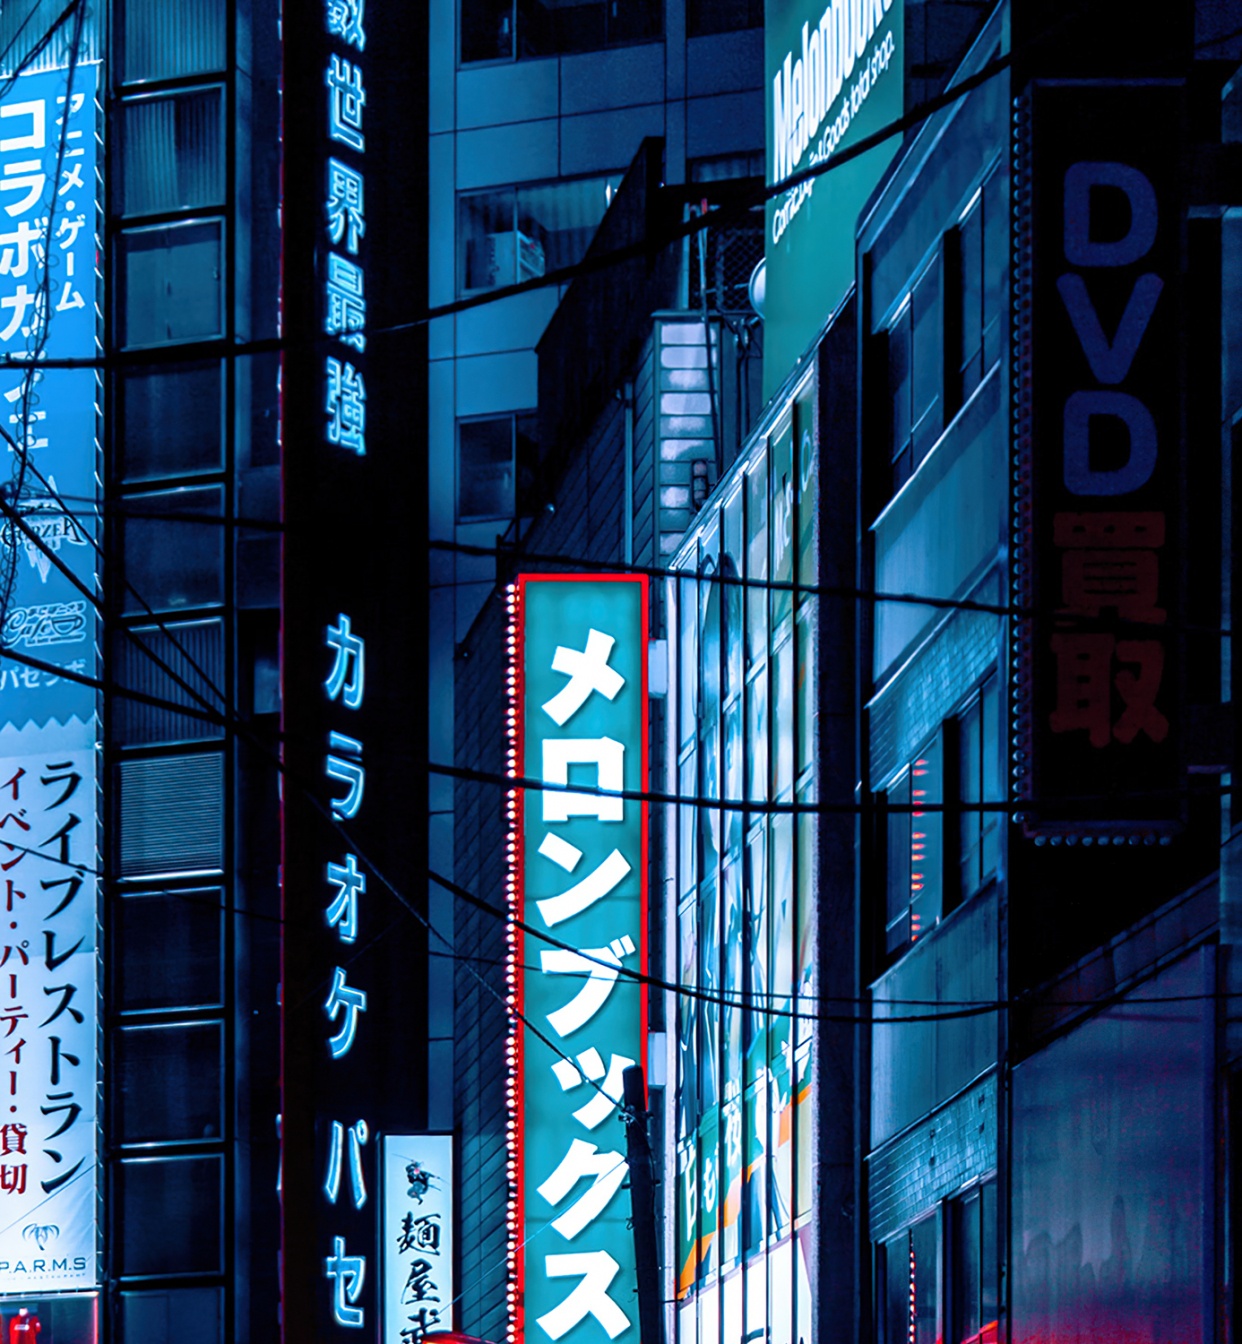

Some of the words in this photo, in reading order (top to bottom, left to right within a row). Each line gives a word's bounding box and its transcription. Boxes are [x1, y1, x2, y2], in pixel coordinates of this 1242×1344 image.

[55, 93, 86, 312] アニメ・ゲーム
[773, 0, 893, 184] Melonboo
[0, 767, 31, 1195] イベント・パーティー・貸切
[38, 761, 86, 1194] ライブレストラン
[325, 612, 368, 1060] カラオケ
[536, 628, 636, 1341] メロンブックス
